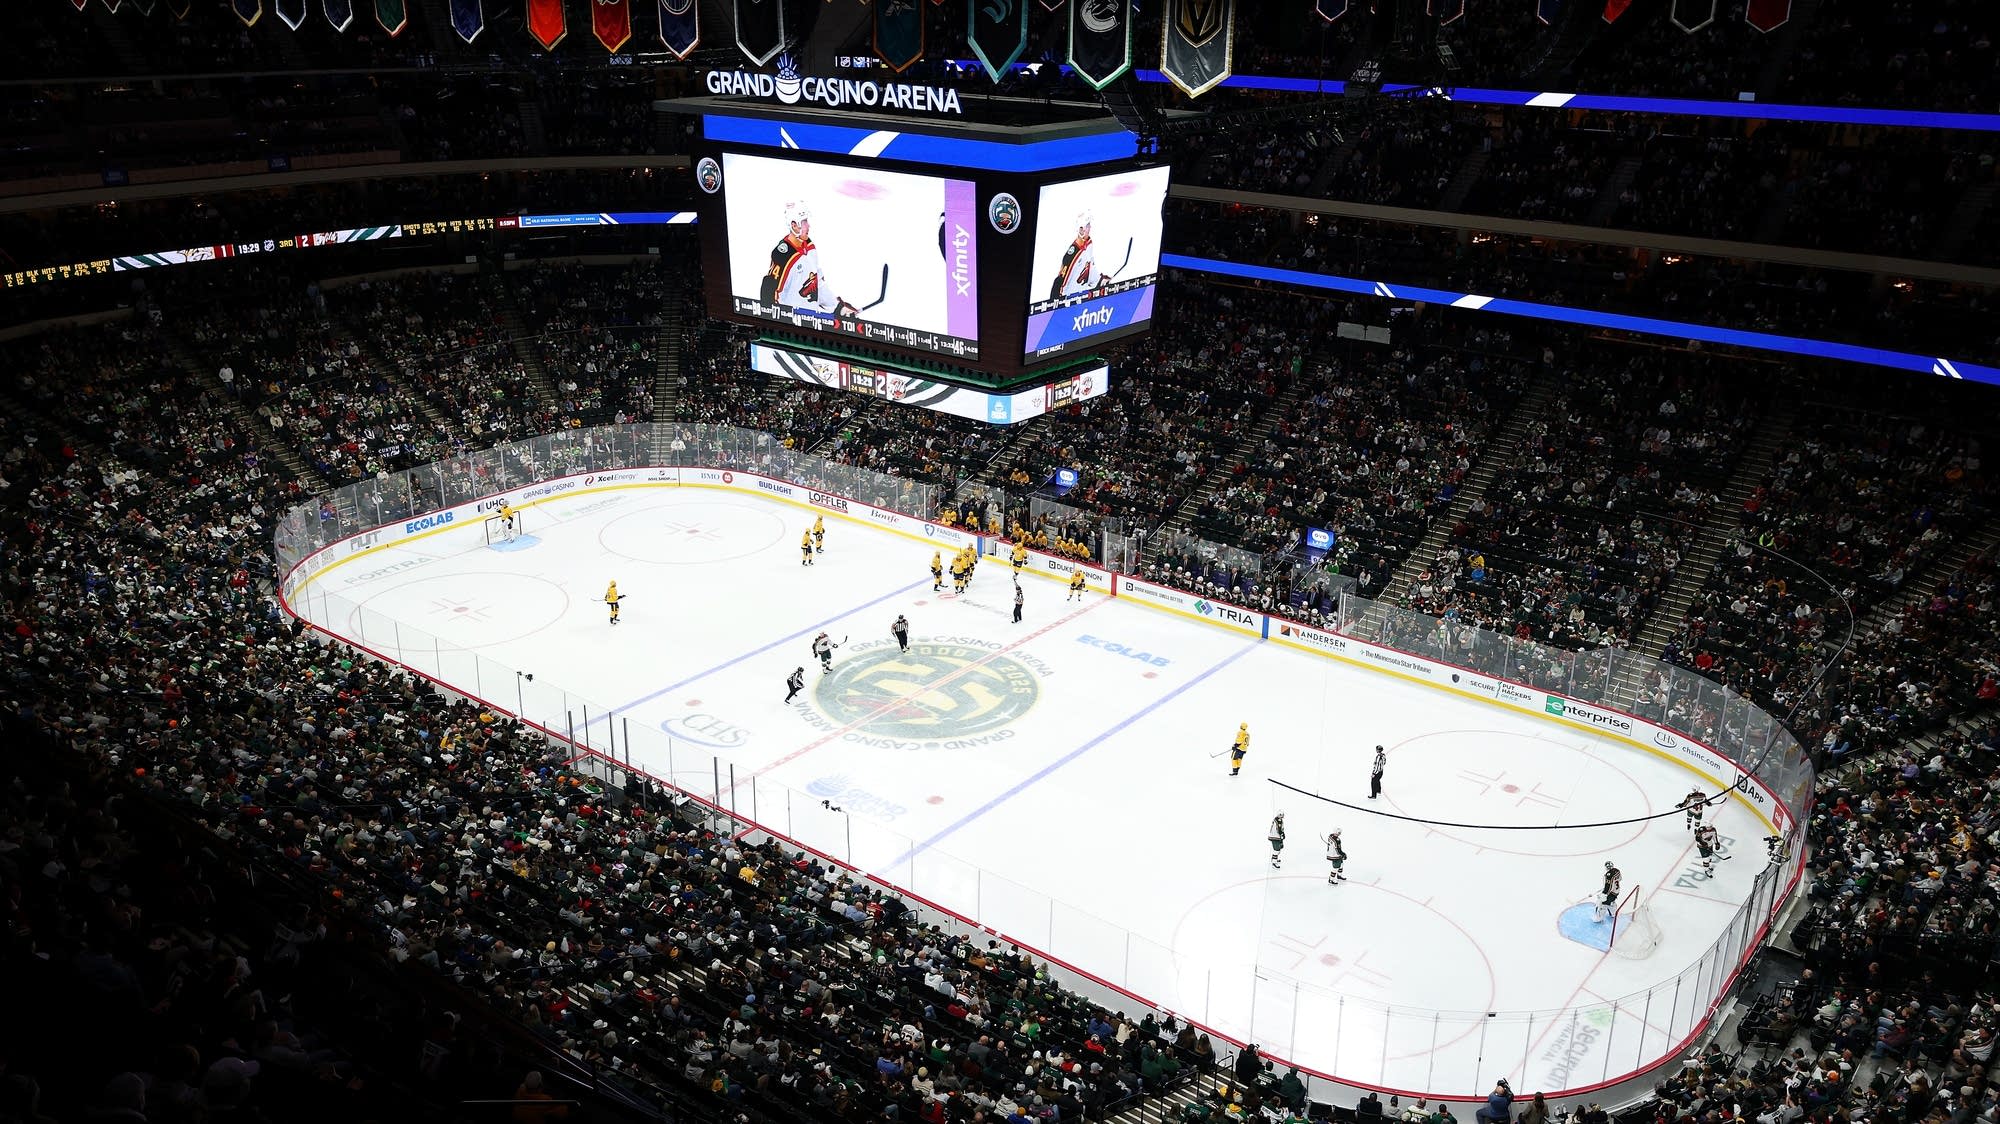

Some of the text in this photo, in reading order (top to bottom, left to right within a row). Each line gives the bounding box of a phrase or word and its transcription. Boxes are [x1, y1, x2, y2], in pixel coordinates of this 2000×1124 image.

[706, 70, 961, 113] GRAND CASINO ARENA
[221, 245, 227, 257] 1
[238, 243, 260, 254] 19:29
[279, 239, 293, 248] 3RD
[301, 235, 309, 247] 2
[26, 270, 39, 278] BLK
[41, 267, 56, 275] HITS
[91, 259, 110, 268] SHOTS
[952, 224, 971, 297] xfinity
[1072, 305, 1114, 332] xfinity
[842, 321, 856, 332] TOI
[865, 324, 872, 337] 12
[886, 328, 894, 341] 14
[909, 332, 917, 346] 91
[934, 337, 939, 350] 5
[954, 341, 965, 355] 46
[841, 366, 847, 387] 1
[852, 374, 873, 387] 19:29
[860, 368, 875, 377] PERIOD
[877, 374, 886, 395] 2
[1055, 387, 1071, 401] 19:29
[1072, 380, 1080, 400] 2
[1046, 388, 1052, 408] 1
[614, 473, 636, 481] Energy
[701, 472, 720, 480] BMO
[523, 481, 575, 499] GRAND CASINO
[759, 480, 792, 495] BUD LIGHT
[485, 498, 505, 510] UHC
[808, 491, 848, 510] LOFFLER
[406, 511, 454, 533] ECOLAB
[936, 527, 961, 540] FANDUEL
[1056, 563, 1102, 582] DUKE NNON
[1217, 606, 1254, 626] TRIA
[1075, 633, 1171, 667] ECOLAB
[1300, 631, 1346, 649] ANDERSEN
[850, 635, 1054, 678] GRAN CASINO ARENA
[1365, 650, 1431, 674] The Minnesota Star Tribune
[999, 664, 1033, 695] 2025
[1470, 680, 1496, 692] SECURE
[1502, 683, 1515, 691] PUT
[1501, 689, 1532, 701] HACKERS
[1552, 701, 1630, 730] enterprise
[681, 713, 750, 745] CHS
[794, 701, 1015, 751] GRAND CASINO ARENA
[1656, 731, 1676, 746] CHS
[1682, 746, 1721, 771] chsinc.com
[1748, 786, 1765, 804] App
